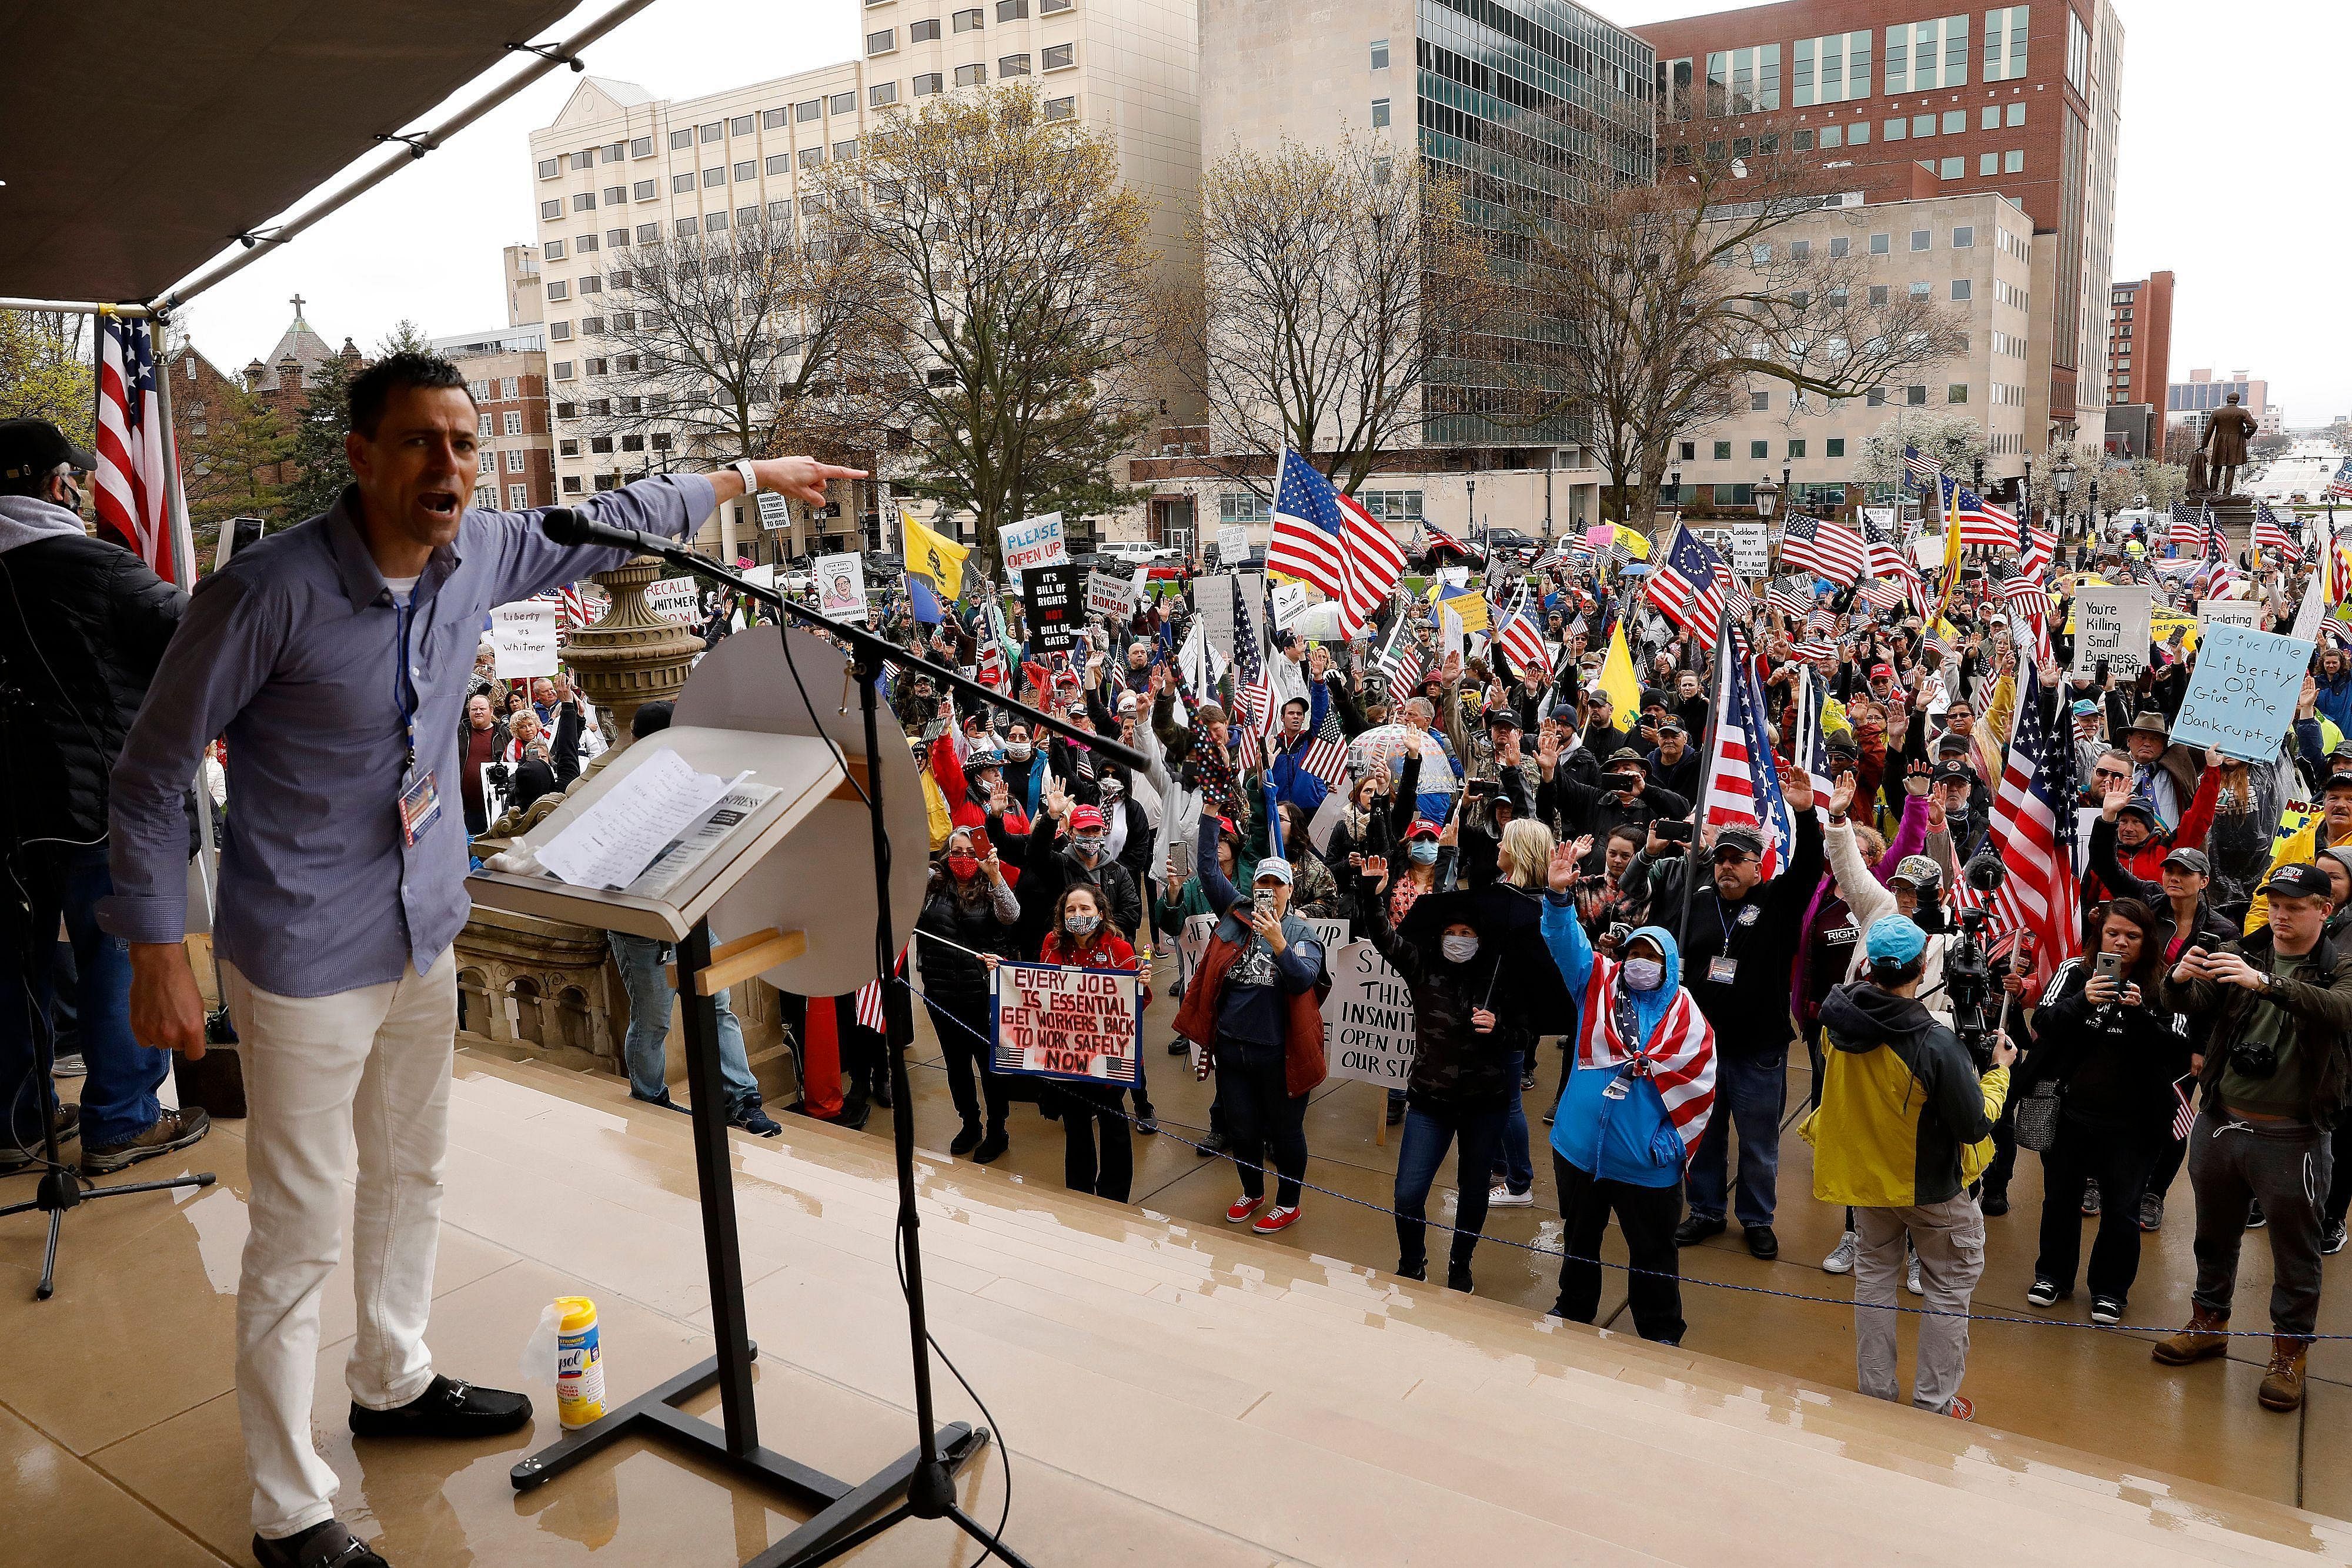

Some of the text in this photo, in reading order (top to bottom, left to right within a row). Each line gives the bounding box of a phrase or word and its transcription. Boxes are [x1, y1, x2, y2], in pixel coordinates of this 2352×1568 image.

[759, 495, 782, 503] DISOBEDIENCE
[767, 511, 786, 520] OBEDIENCE
[1007, 522, 1060, 550] PLEASE
[1732, 526, 1758, 536] Lockdown
[738, 556, 755, 567] FREE
[1007, 541, 1062, 569] OPEN UP
[1042, 573, 1057, 583] IT'S
[1102, 580, 1122, 591] VACCINE
[1795, 573, 1813, 589] OUR
[646, 579, 690, 597] RECALL
[1036, 583, 1066, 595] BILL OF
[1106, 589, 1117, 599] the
[1037, 594, 1068, 607] RIGHTS
[1092, 594, 1128, 615] BOXCAR
[2086, 601, 2117, 616] You're
[503, 612, 540, 622] Liberty
[1045, 609, 1063, 621] NOT
[1279, 604, 1304, 623] NOVEMBER COMETH
[2203, 614, 2252, 628] Isolating
[1040, 623, 1071, 635] BILL OF
[2086, 617, 2121, 634] Killing
[503, 641, 546, 651] Whitmer
[1044, 635, 1070, 646] GATES
[2087, 634, 2119, 648] Small
[2214, 627, 2301, 660] Give Me
[2204, 647, 2297, 687] Liberty
[2193, 686, 2229, 704] Give
[2224, 677, 2259, 697] OR
[2182, 704, 2286, 755] Bankruptcy
[2286, 798, 2308, 814] NO
[1014, 968, 1118, 995] EVERY JOB
[1021, 989, 1131, 1017] IS ESSENTIAL
[1359, 981, 1412, 1008] THIS
[1001, 1006, 1135, 1037] GET WORKERS BACK
[1342, 1001, 1416, 1034] INSANIT
[1013, 1027, 1130, 1057] TO WORK SAFELY
[1340, 1028, 1388, 1053] OPEN
[1044, 1049, 1090, 1074] NOW
[1341, 1051, 1381, 1075] OUR
[559, 1350, 580, 1373] ysol
